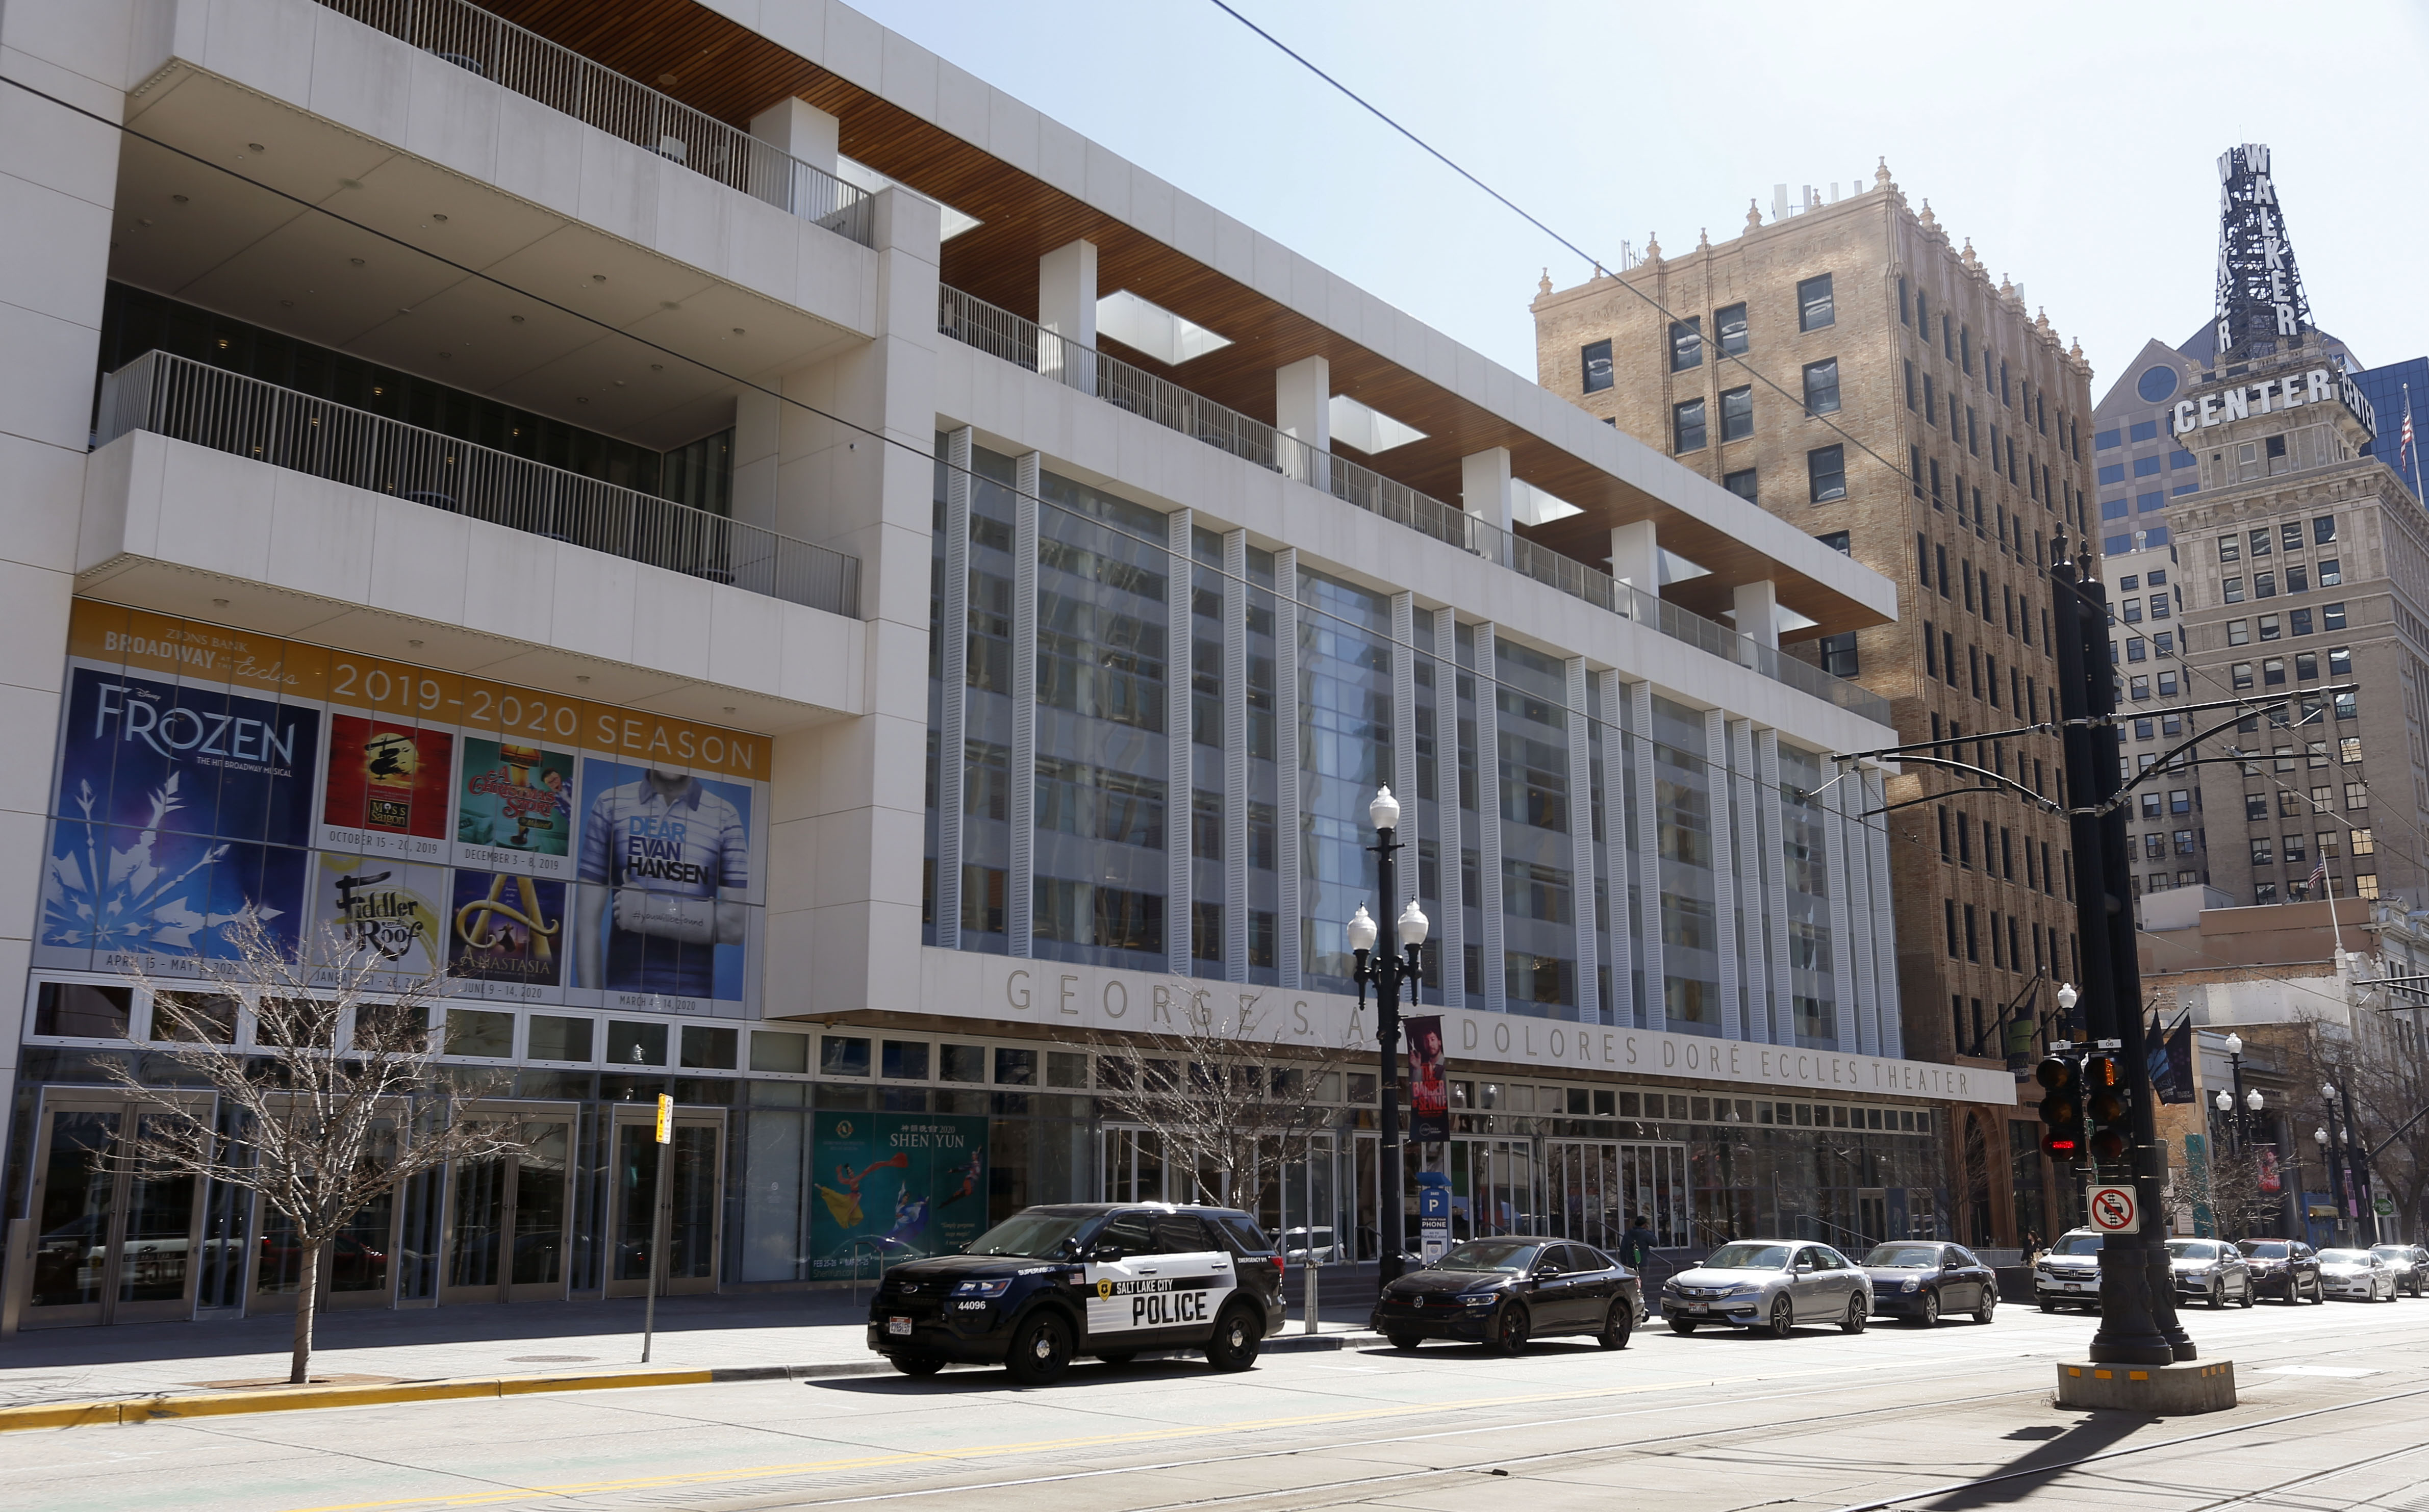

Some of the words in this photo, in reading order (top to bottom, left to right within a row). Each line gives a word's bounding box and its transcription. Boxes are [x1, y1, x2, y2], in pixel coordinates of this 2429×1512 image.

[2216, 147, 2233, 354] WALKER
[2243, 143, 2297, 336] WALKER
[2173, 369, 2333, 435] CENTER
[2342, 368, 2377, 439] CENTER
[165, 628, 208, 645] ZIONS
[211, 637, 249, 653] BANK
[104, 630, 217, 669] BROADWAY
[233, 656, 300, 684] Eccles
[135, 687, 162, 702] Disney
[95, 682, 295, 765] FROZEN
[334, 664, 576, 736] 2019-2020
[597, 715, 752, 770] SEASON
[196, 756, 211, 765] THE
[212, 759, 223, 767] HIT
[224, 760, 262, 773] BROADWAY
[263, 767, 293, 777] MUSICAL
[468, 775, 556, 803] CHRISTMAS
[371, 811, 406, 825] Saigon
[502, 798, 558, 818] STORY
[629, 816, 687, 842] DEAR
[330, 831, 372, 846] OCTOBER
[376, 837, 386, 848] 15
[416, 842, 437, 854] 2019
[628, 836, 681, 861] EVAN
[465, 849, 510, 864] DECEMBER
[513, 855, 518, 865] 3
[539, 859, 559, 870] 2019
[627, 857, 709, 885] HANSEN
[335, 871, 419, 940] Fiddler
[356, 919, 424, 962] Roof
[171, 960, 194, 971] MAY
[460, 945, 551, 975] ANASTASIA
[489, 984, 494, 994] 9
[505, 986, 517, 997] 14,
[521, 987, 542, 998] 2020
[619, 995, 646, 1007] MARCH
[664, 999, 674, 1010] 14,
[677, 1000, 696, 1010] 2020
[1006, 969, 1255, 1031] GEORGE
[1294, 1000, 1314, 1036] S.
[1463, 1018, 1637, 1065] DOLORES
[1663, 1040, 1740, 1074] DORÉ
[1761, 1050, 1857, 1084] ECCLES
[1871, 1063, 1968, 1095] THEATER
[1412, 1080, 1445, 1097] BARBER
[1419, 1095, 1447, 1110] SEVILLE
[890, 1133, 929, 1148] SHEN
[935, 1134, 965, 1148] YUN
[939, 1125, 955, 1134] 2020
[1429, 1199, 1439, 1212] P
[1017, 1266, 1057, 1276] SUPERVISOR
[1116, 1281, 1135, 1295] SALT
[1136, 1279, 1156, 1293] LAKE
[1157, 1278, 1174, 1292] CITY
[957, 1300, 986, 1311] 44096
[1132, 1291, 1208, 1327] POLICE
